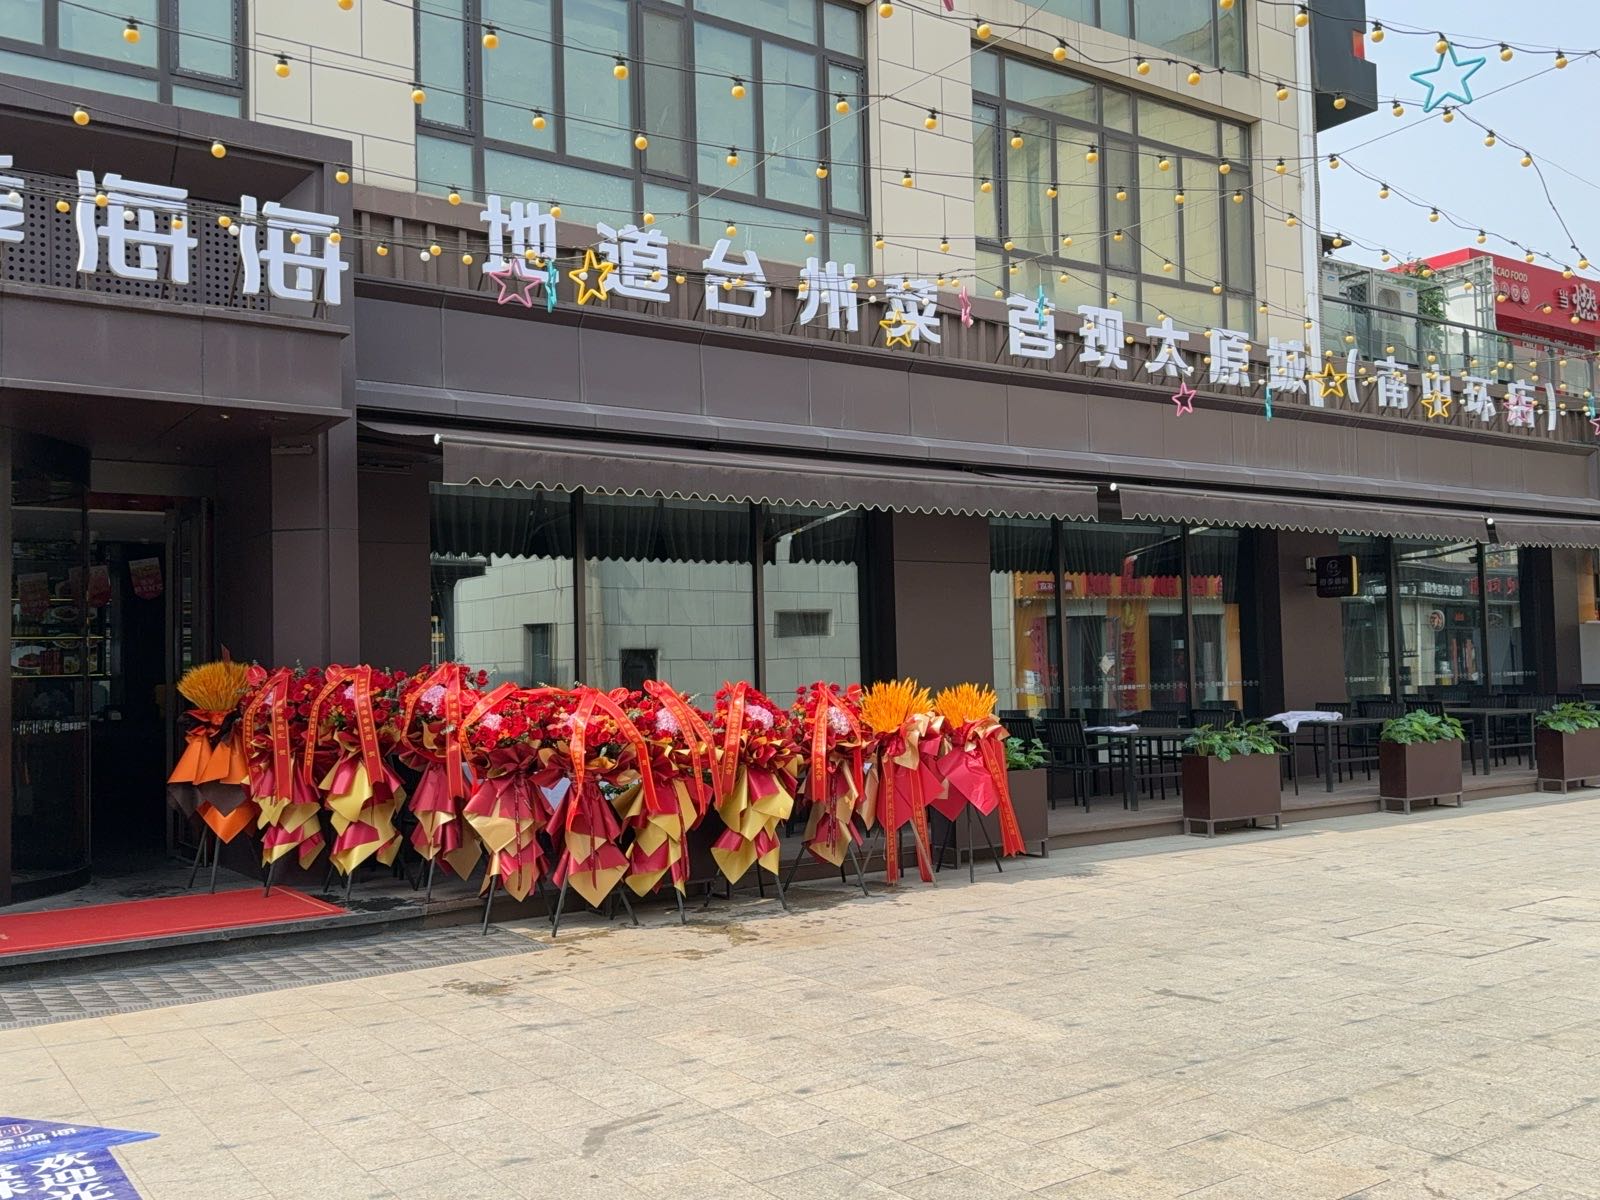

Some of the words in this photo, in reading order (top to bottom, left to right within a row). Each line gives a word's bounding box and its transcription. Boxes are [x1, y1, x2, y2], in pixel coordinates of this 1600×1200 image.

[0, 155, 349, 306] 海海
[480, 195, 942, 344] 地道台州菜
[1510, 269, 1528, 283] FOOD
